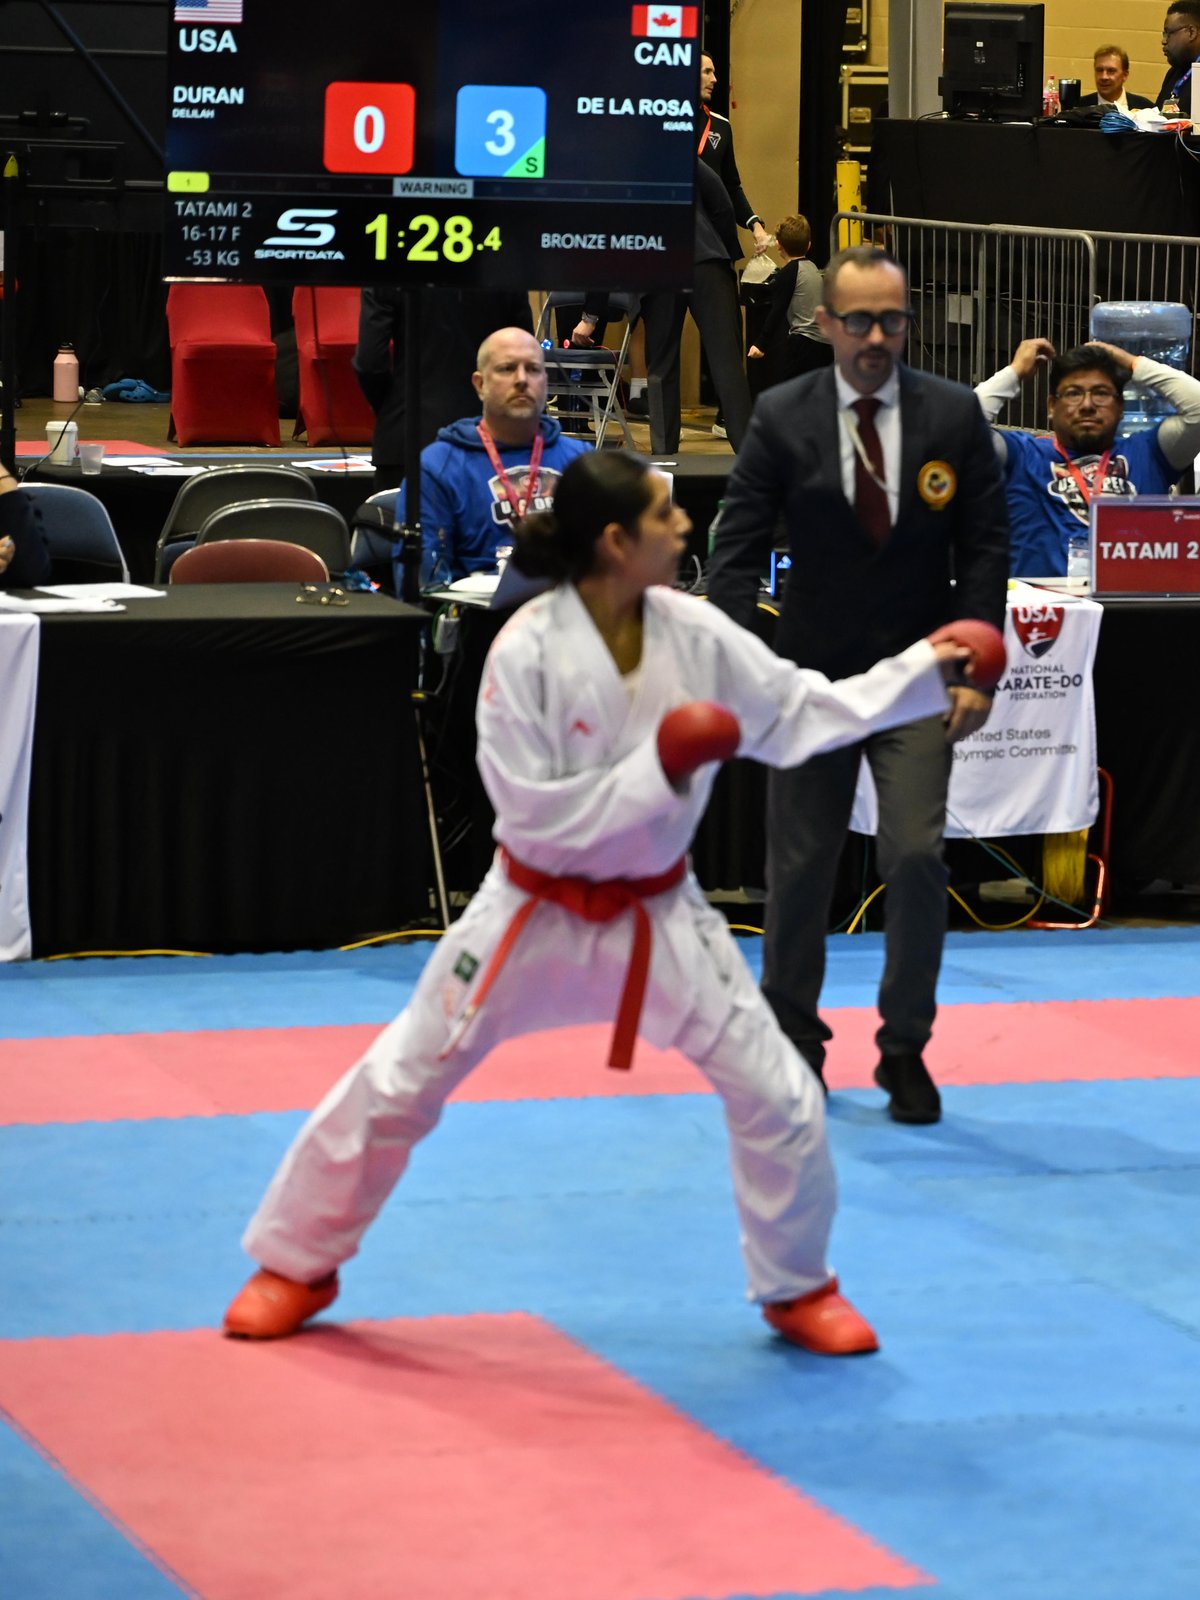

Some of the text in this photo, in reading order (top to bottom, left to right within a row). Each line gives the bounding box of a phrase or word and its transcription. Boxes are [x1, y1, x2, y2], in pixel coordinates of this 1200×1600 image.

[179, 28, 238, 53] USA
[634, 42, 691, 66] CAN
[173, 85, 244, 104] DURAN
[172, 109, 215, 119] DELILAH
[577, 97, 694, 117] DE LA ROSA
[353, 105, 386, 154] 0
[485, 109, 516, 156] 3
[525, 157, 539, 173] S
[400, 182, 468, 195] WARNING
[174, 201, 252, 218] TATAMI 2
[181, 225, 241, 241] 16-17 F
[541, 233, 666, 251] BRONZE MEDAL
[185, 251, 240, 266] -53 KG
[254, 249, 345, 260] SPORTDATA
[1099, 541, 1200, 560] TATAMI 2
[1017, 605, 1058, 624] USA
[1011, 664, 1065, 675] NATIONAL
[1009, 690, 1067, 701] FEDERATION
[966, 728, 1051, 743] nited States
[952, 747, 1005, 762] alympic
